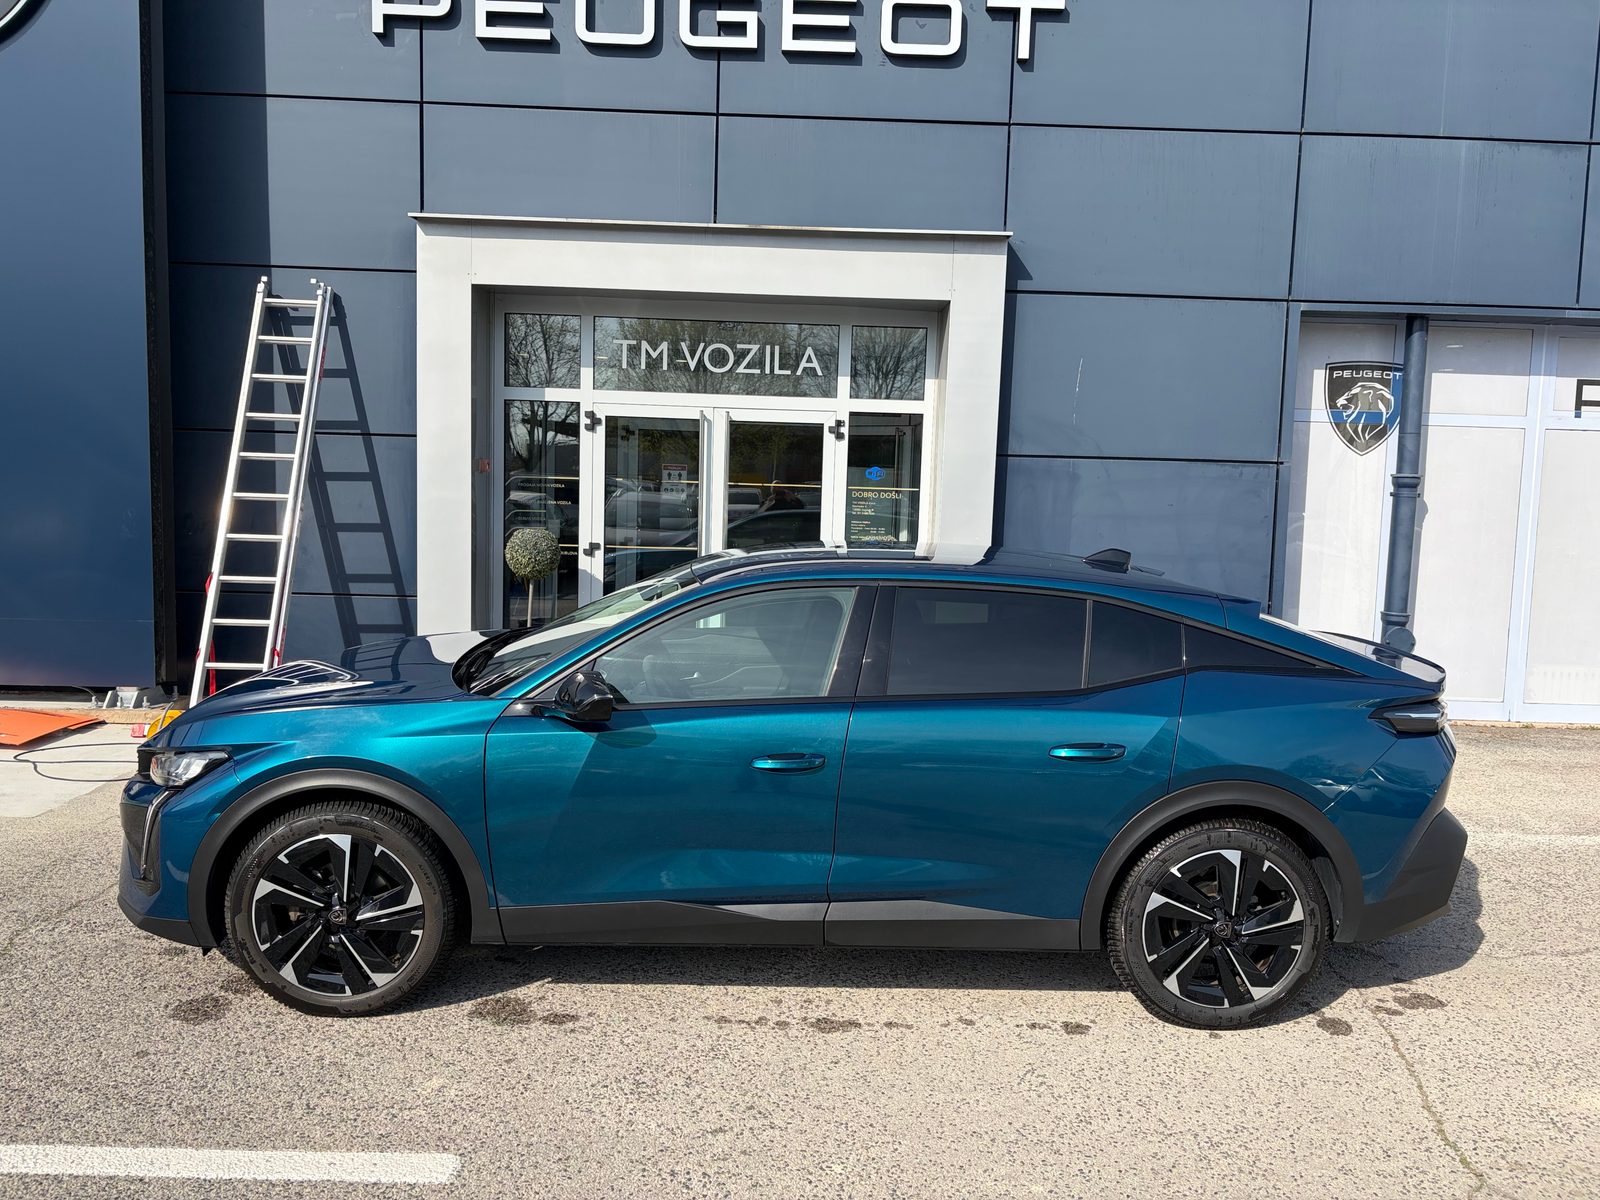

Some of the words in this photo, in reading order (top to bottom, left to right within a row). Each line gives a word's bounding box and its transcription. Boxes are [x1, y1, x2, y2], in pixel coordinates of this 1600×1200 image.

[371, 0, 1066, 60] PEUGEOT
[613, 339, 668, 371] TM
[680, 341, 823, 376] VOZILA
[1333, 370, 1403, 380] PEUGEOT
